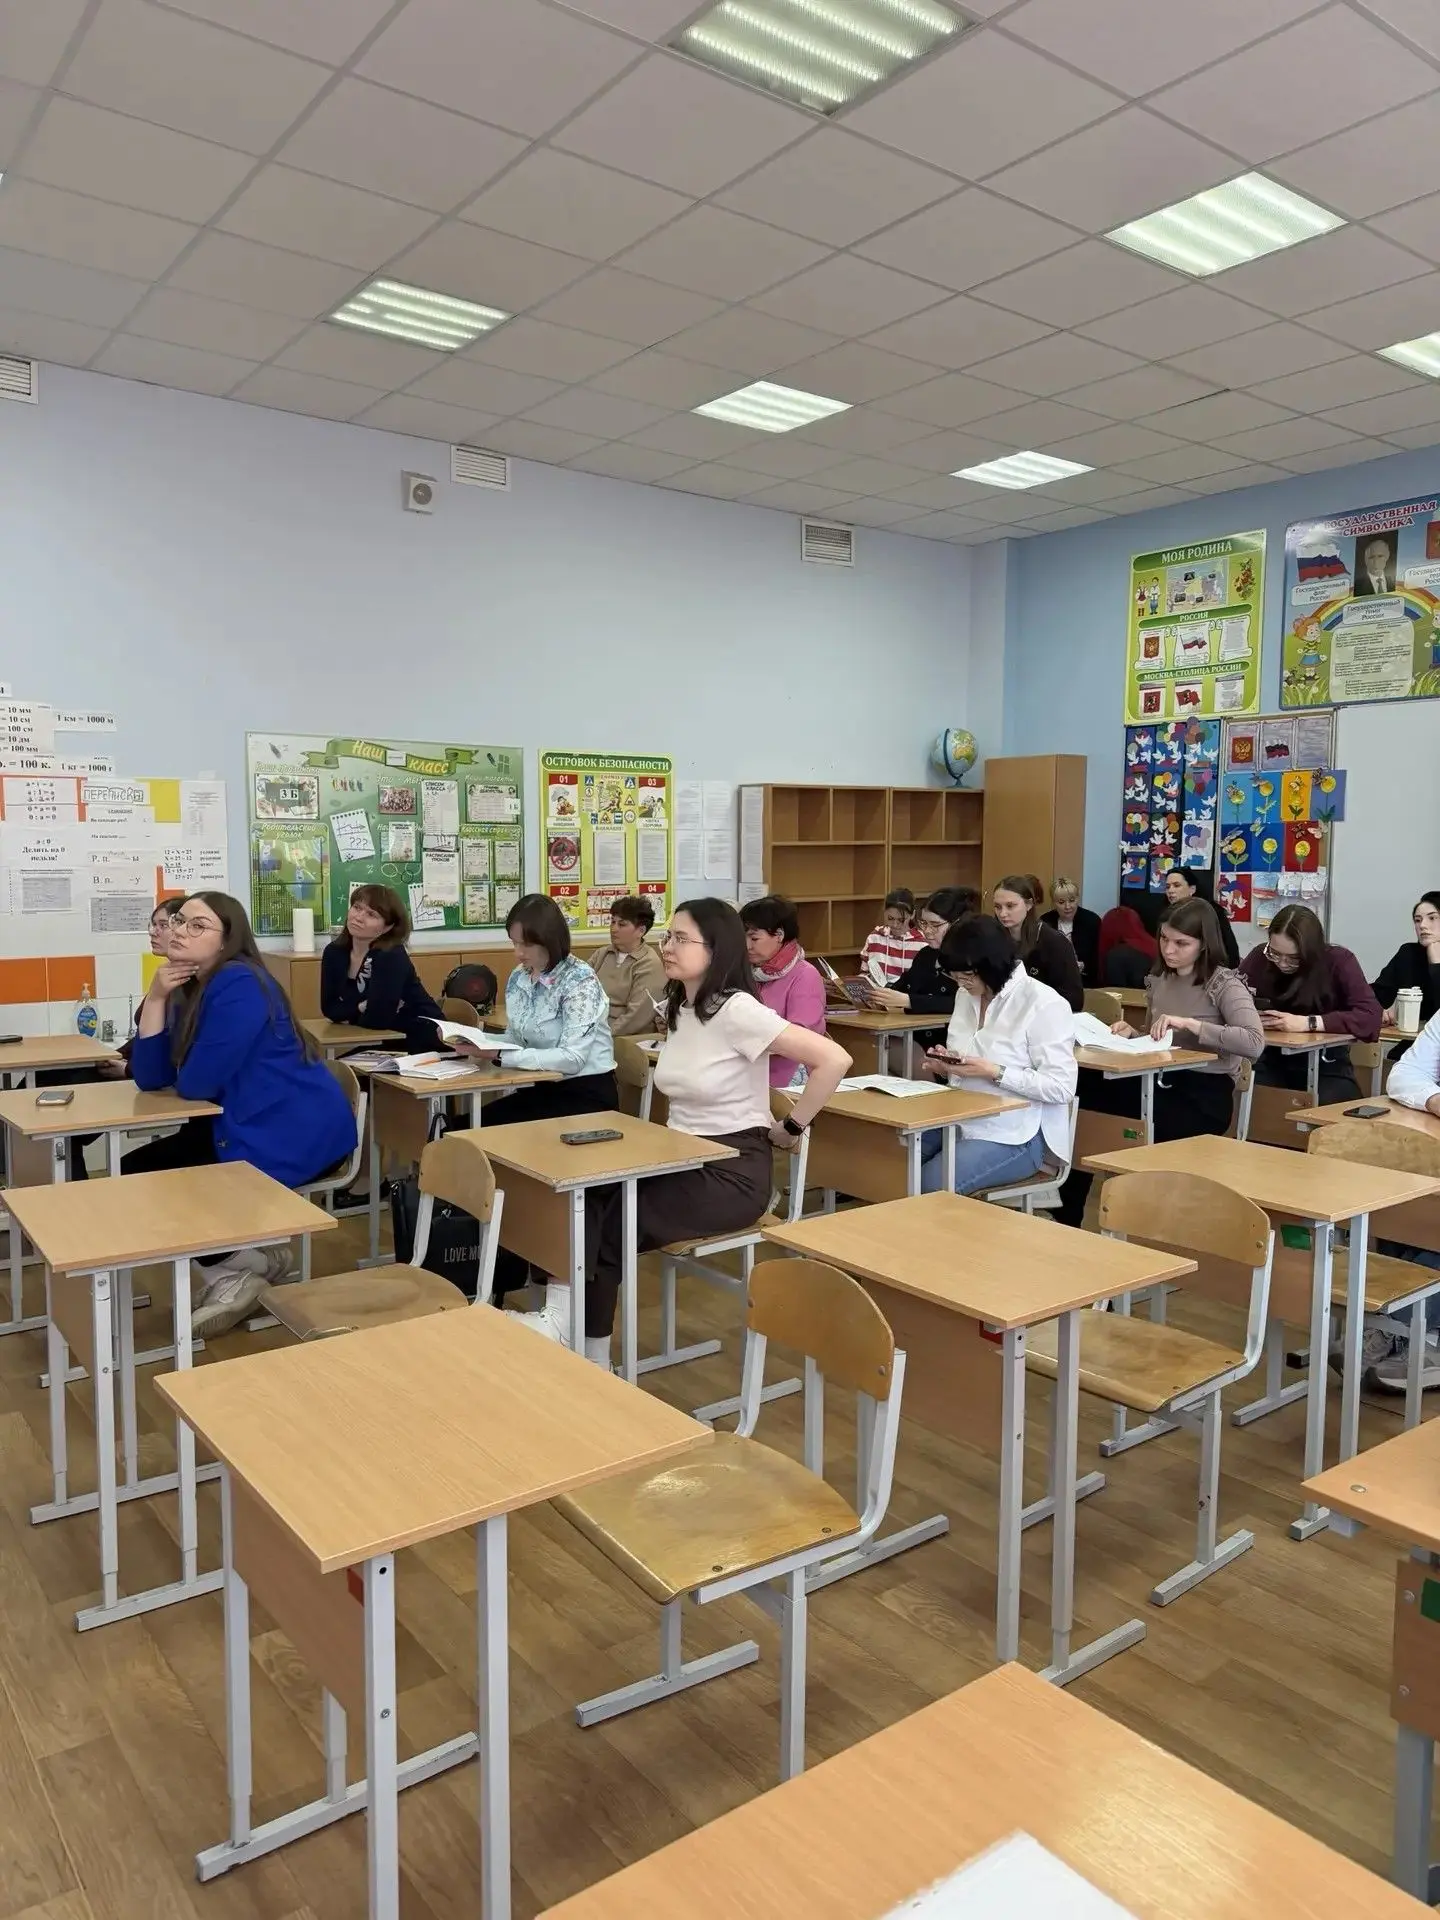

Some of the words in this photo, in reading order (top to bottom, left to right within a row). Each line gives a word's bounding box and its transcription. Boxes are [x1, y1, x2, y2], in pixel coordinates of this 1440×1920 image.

[1343, 516, 1415, 537] СИМВОЛИКА
[1161, 549, 1185, 564] МОЯ
[1187, 541, 1233, 560] РОДИНА
[1179, 611, 1209, 622] РОССИЯ
[1213, 663, 1242, 674] РОССИИ
[352, 740, 385, 760] Наш
[20, 760, 38, 769] 100
[41, 761, 51, 769] к.
[88, 764, 106, 772] 1000
[546, 757, 598, 768] ОСТРОВОК
[599, 759, 669, 770] БЕЗОПАСНОСТИ
[559, 775, 569, 783] 01
[647, 778, 657, 786] 03
[281, 789, 287, 798] 3
[290, 790, 298, 798] Б
[444, 1247, 467, 1263] LOVE
